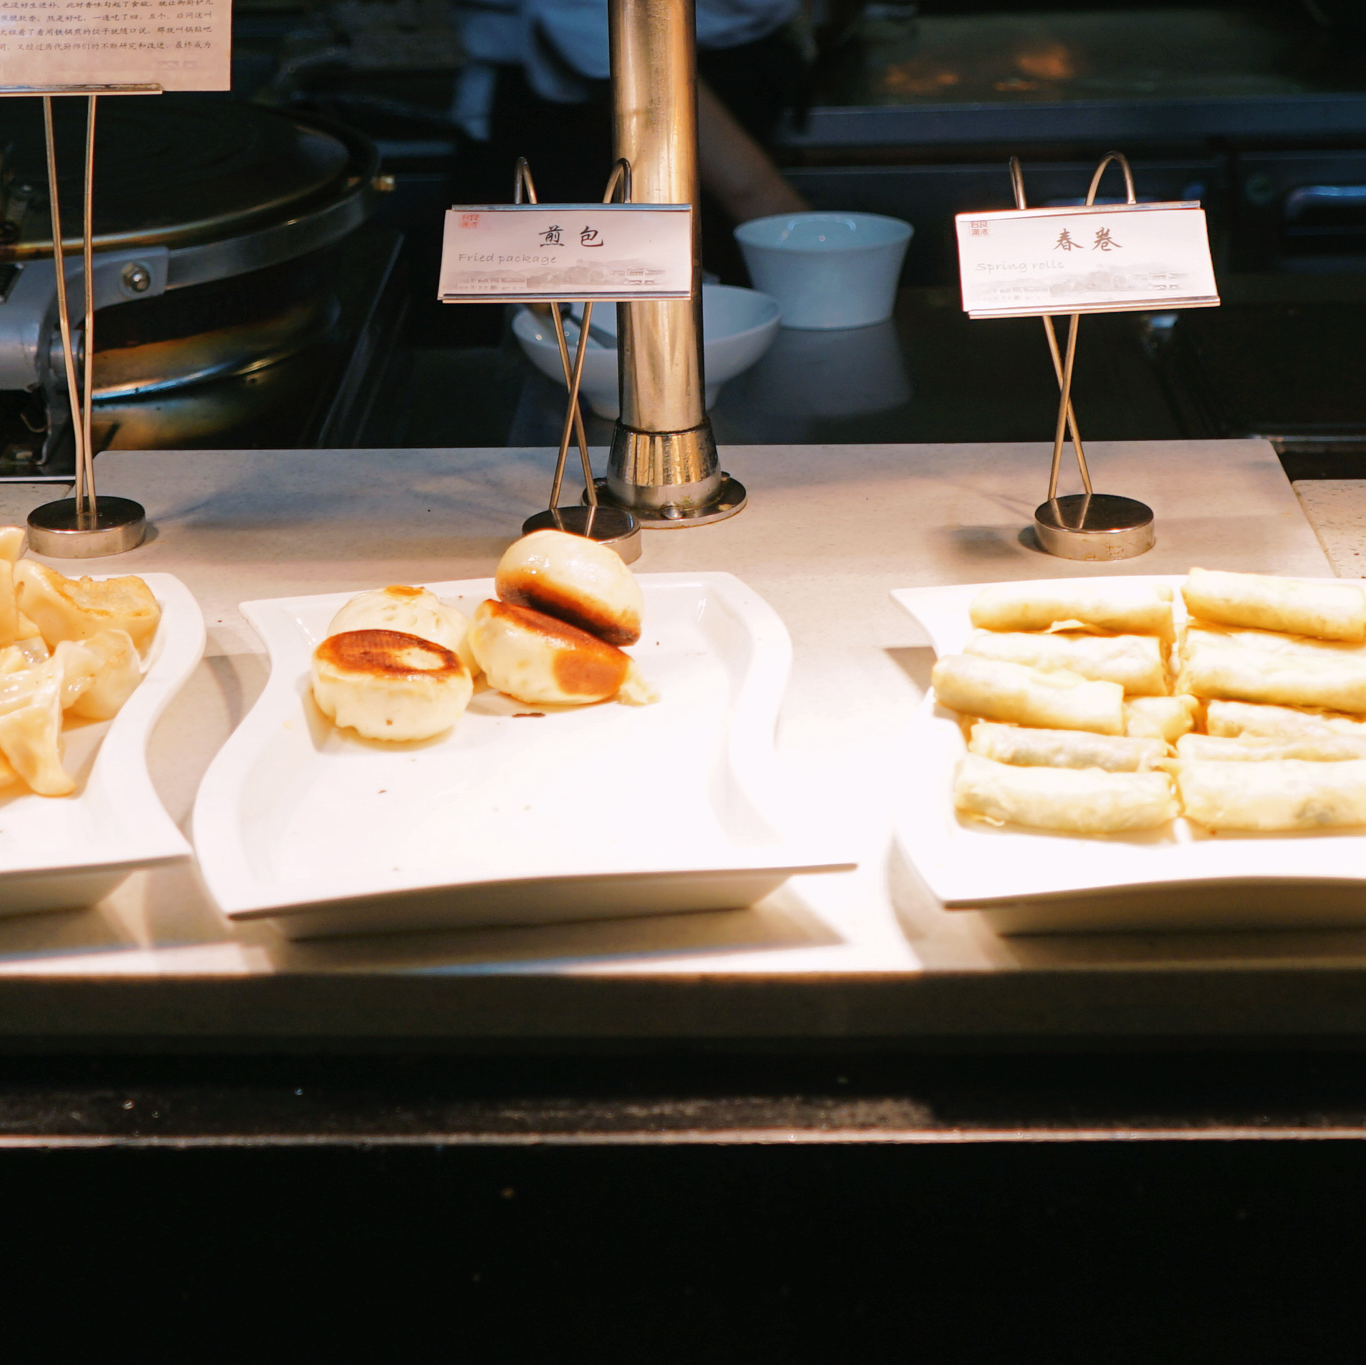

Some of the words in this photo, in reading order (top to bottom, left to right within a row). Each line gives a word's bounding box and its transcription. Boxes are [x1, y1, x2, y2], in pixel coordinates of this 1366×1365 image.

[538, 225, 604, 247] 煎包
[1054, 227, 1123, 252] 春卷
[459, 253, 494, 263] Fried
[498, 254, 557, 266] package
[1032, 260, 1065, 270] rolls
